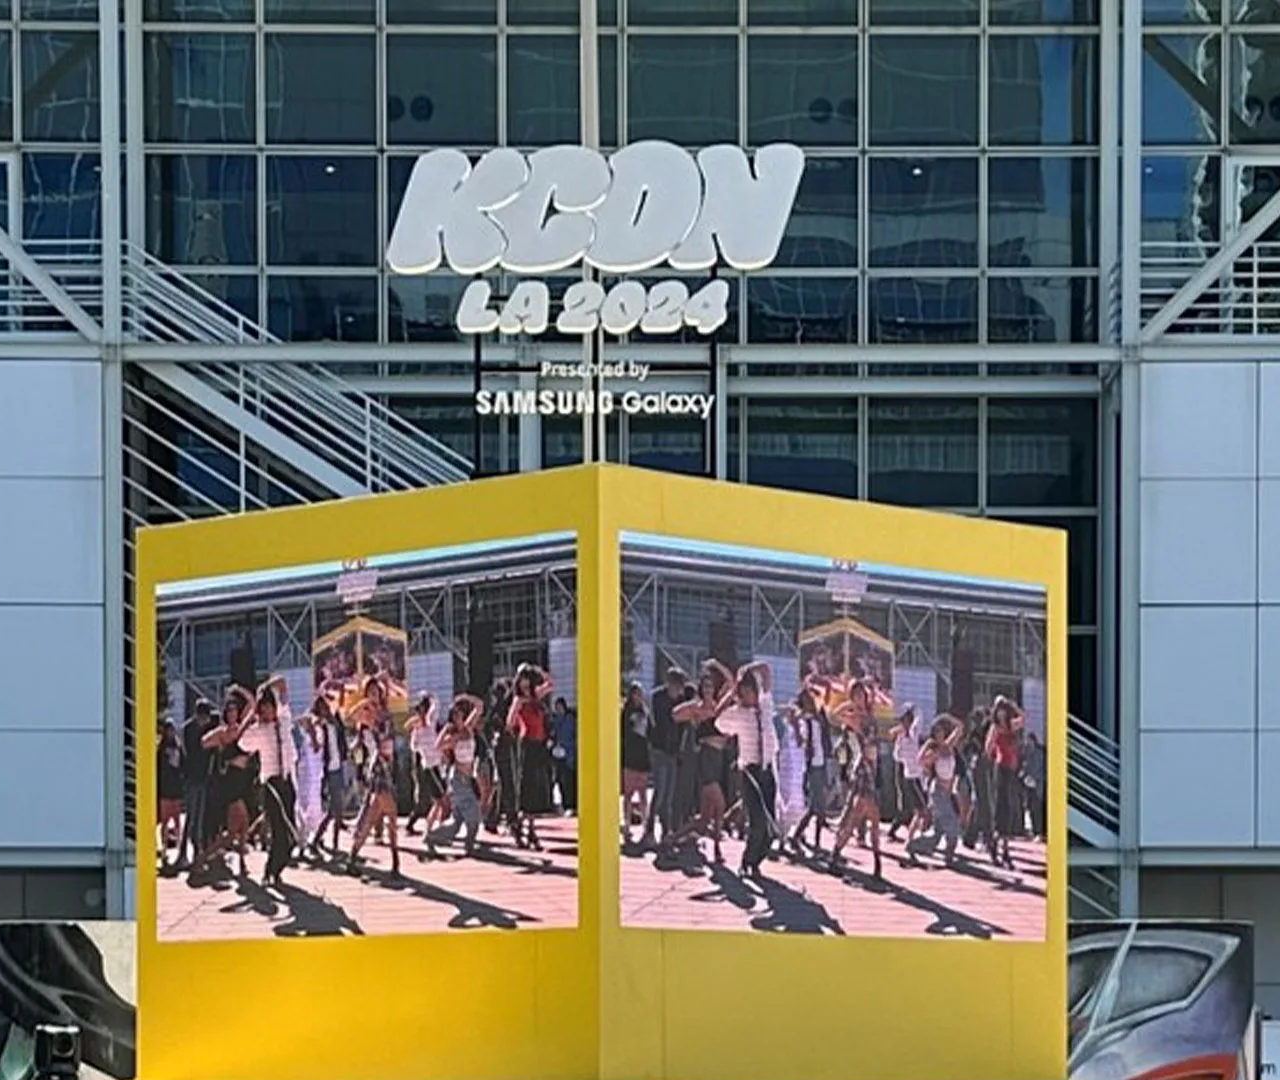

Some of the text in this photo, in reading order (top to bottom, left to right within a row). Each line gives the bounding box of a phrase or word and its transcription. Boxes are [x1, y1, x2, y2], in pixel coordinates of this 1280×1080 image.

[386, 140, 806, 274] KCON
[456, 279, 730, 334] LA 2024
[540, 361, 650, 382] Presented by
[475, 389, 715, 420] SAMSUNG Galaxy
